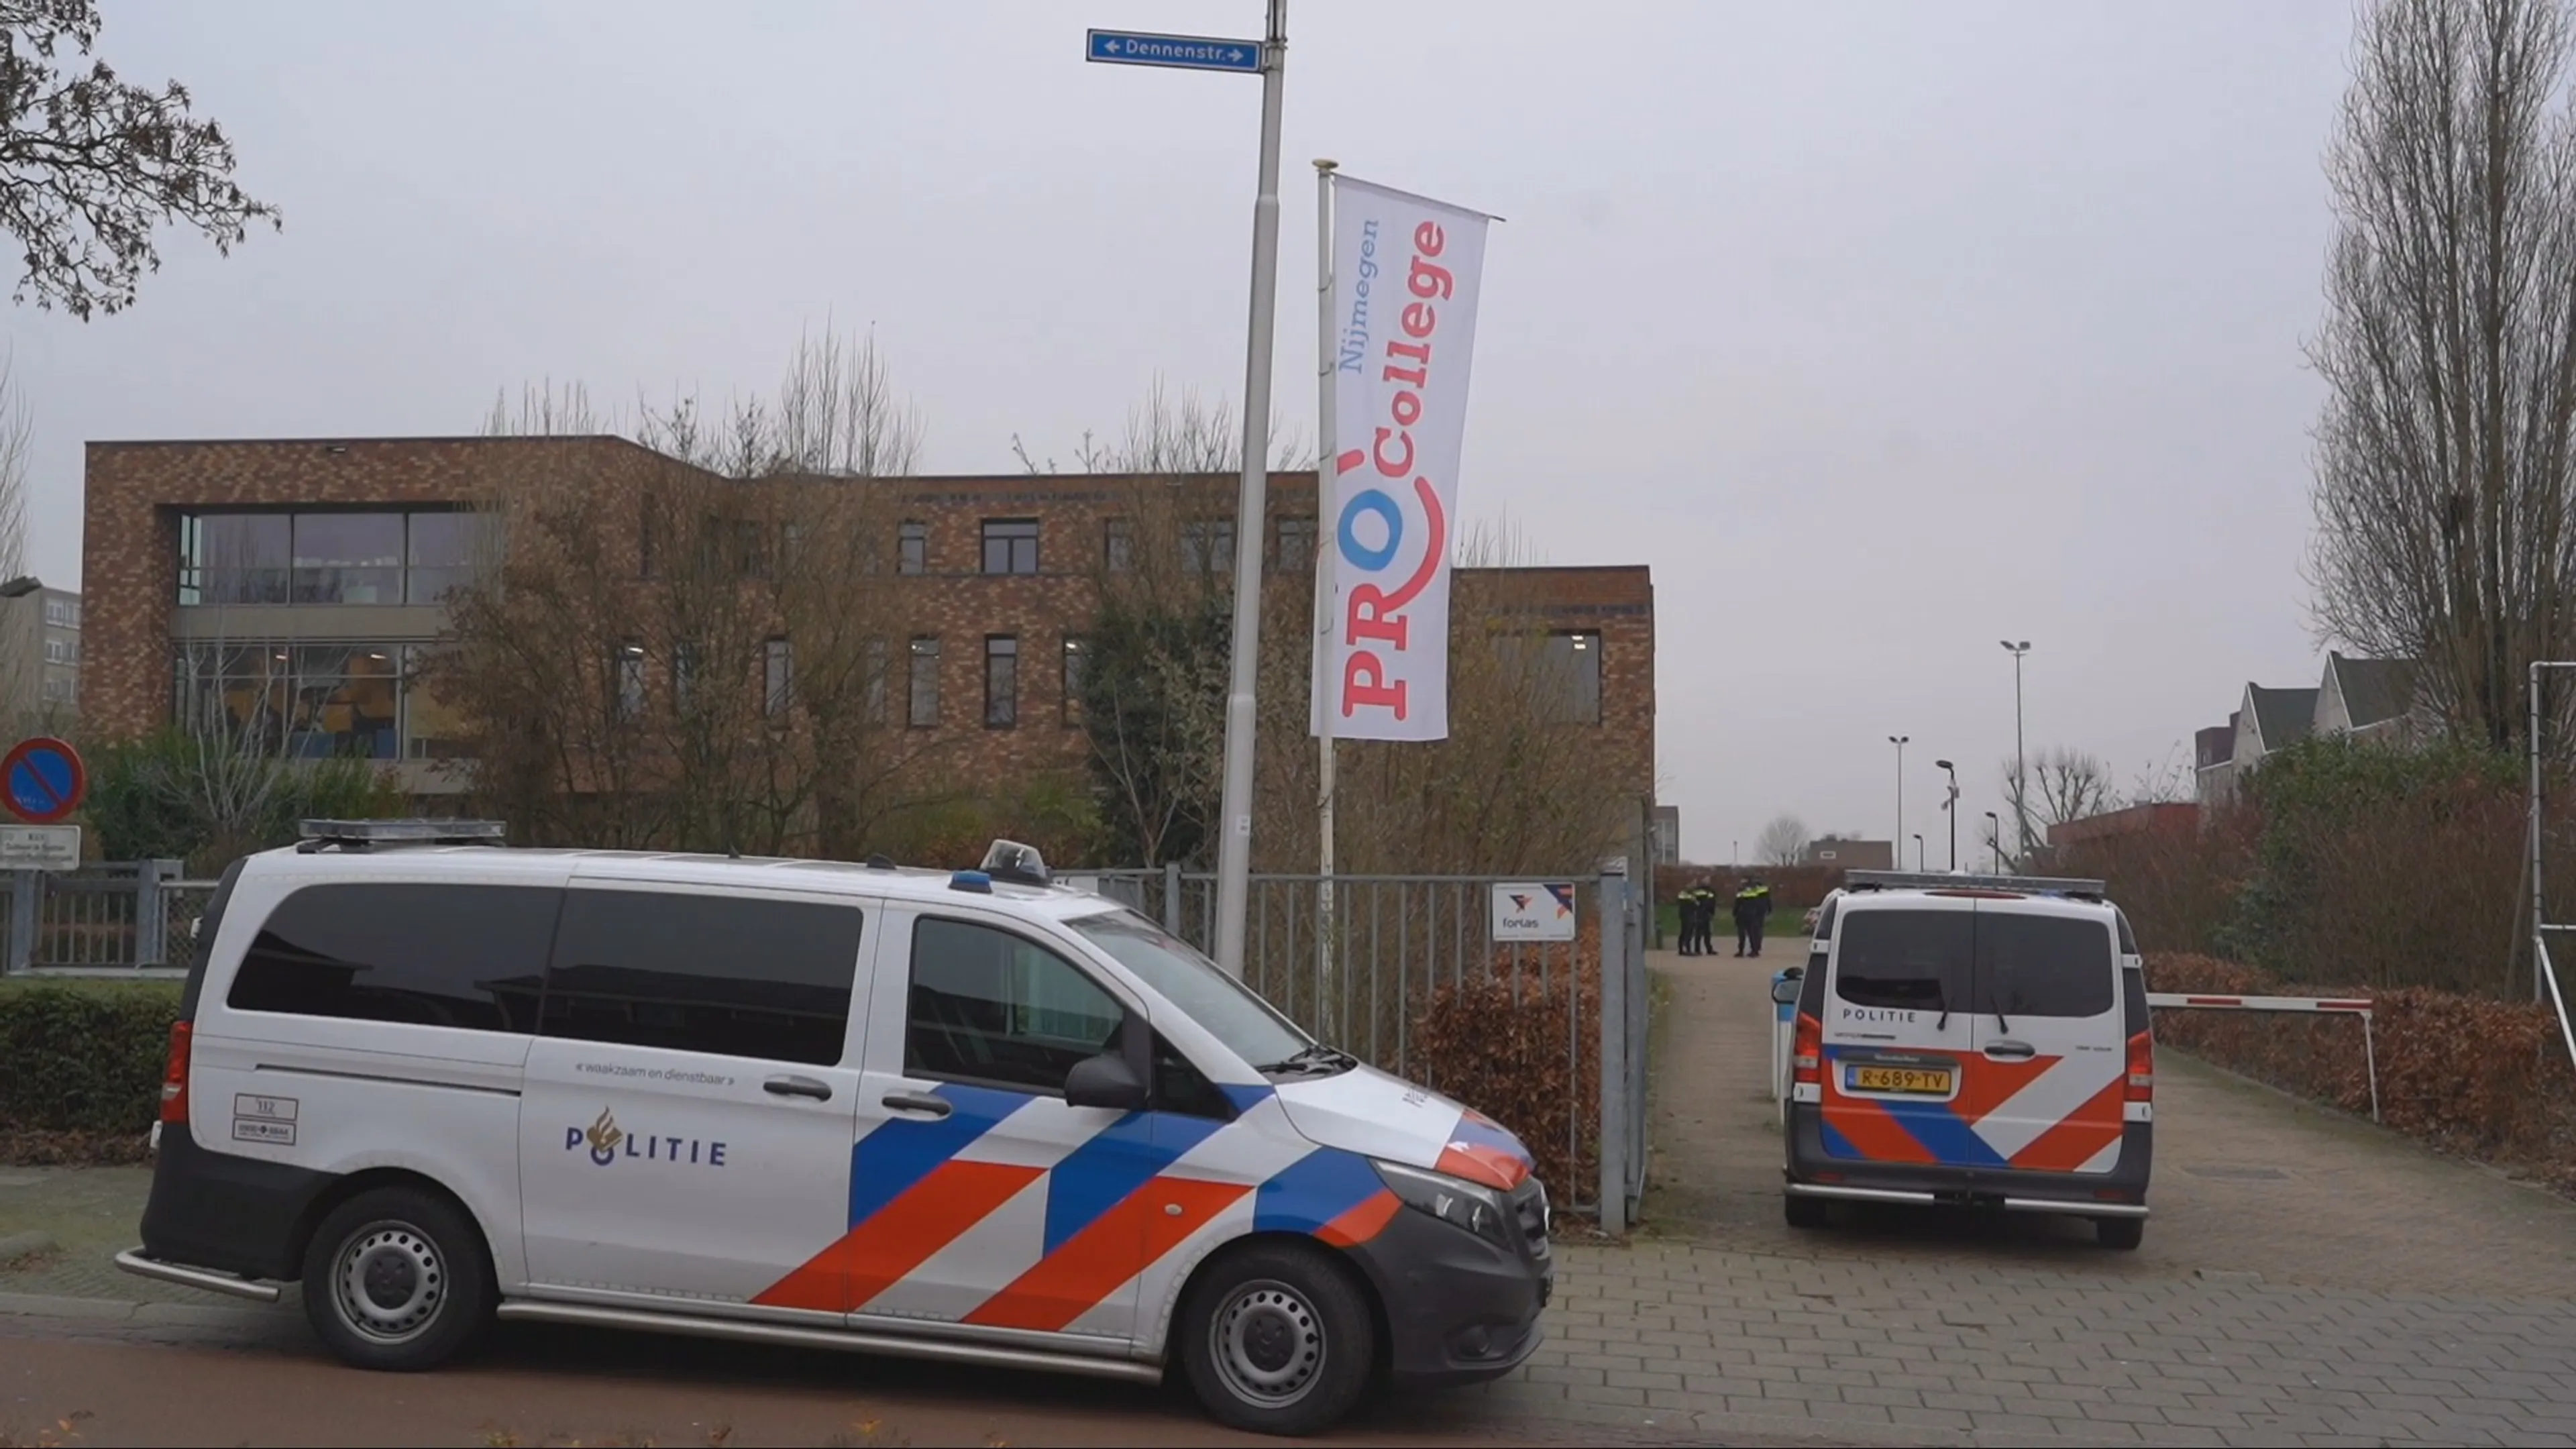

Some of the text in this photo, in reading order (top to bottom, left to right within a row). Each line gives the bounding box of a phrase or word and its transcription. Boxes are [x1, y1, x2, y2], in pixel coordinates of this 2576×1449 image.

[1126, 39, 1226, 60] Dennenstr.
[1338, 219, 1379, 374] Nijmegen
[1843, 1009, 1916, 1022] POLITIE
[647, 1068, 662, 1079] en
[1862, 1070, 1943, 1088] R-689-TV
[566, 1126, 726, 1166] POLITIE
